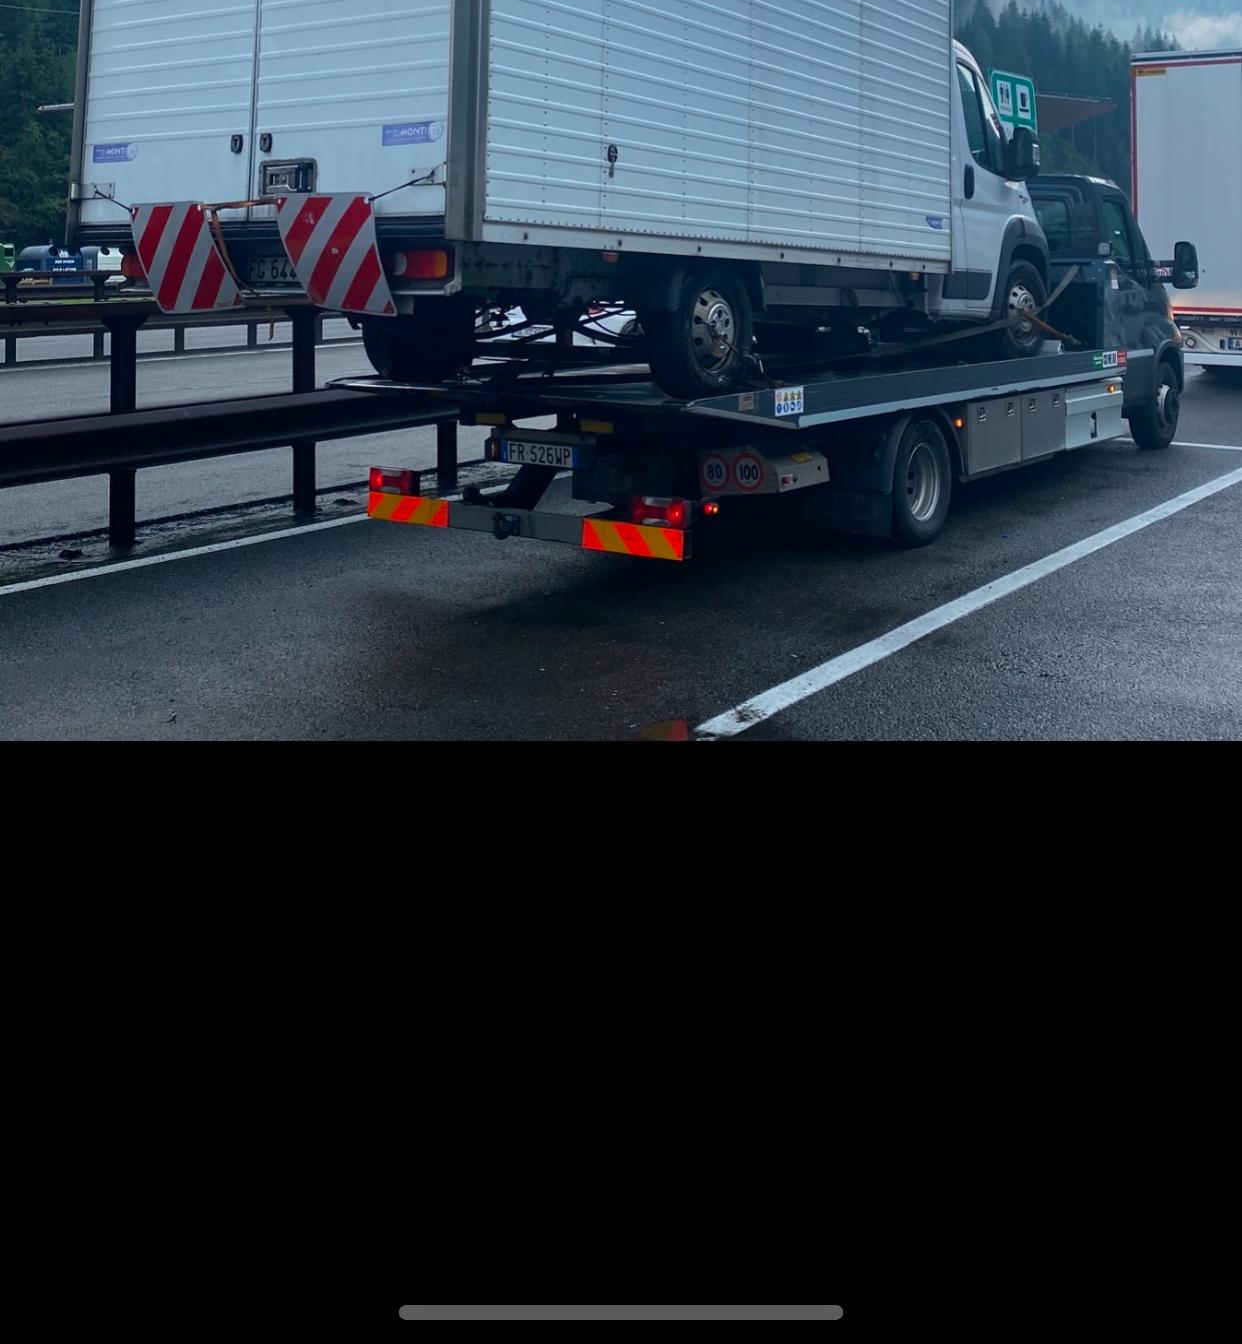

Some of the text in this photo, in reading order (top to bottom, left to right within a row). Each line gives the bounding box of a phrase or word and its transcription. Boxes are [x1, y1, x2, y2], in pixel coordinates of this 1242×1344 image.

[399, 126, 428, 137] MONTI
[509, 442, 571, 466] FR 526WP
[707, 463, 722, 479] 80
[739, 464, 759, 481] 100
